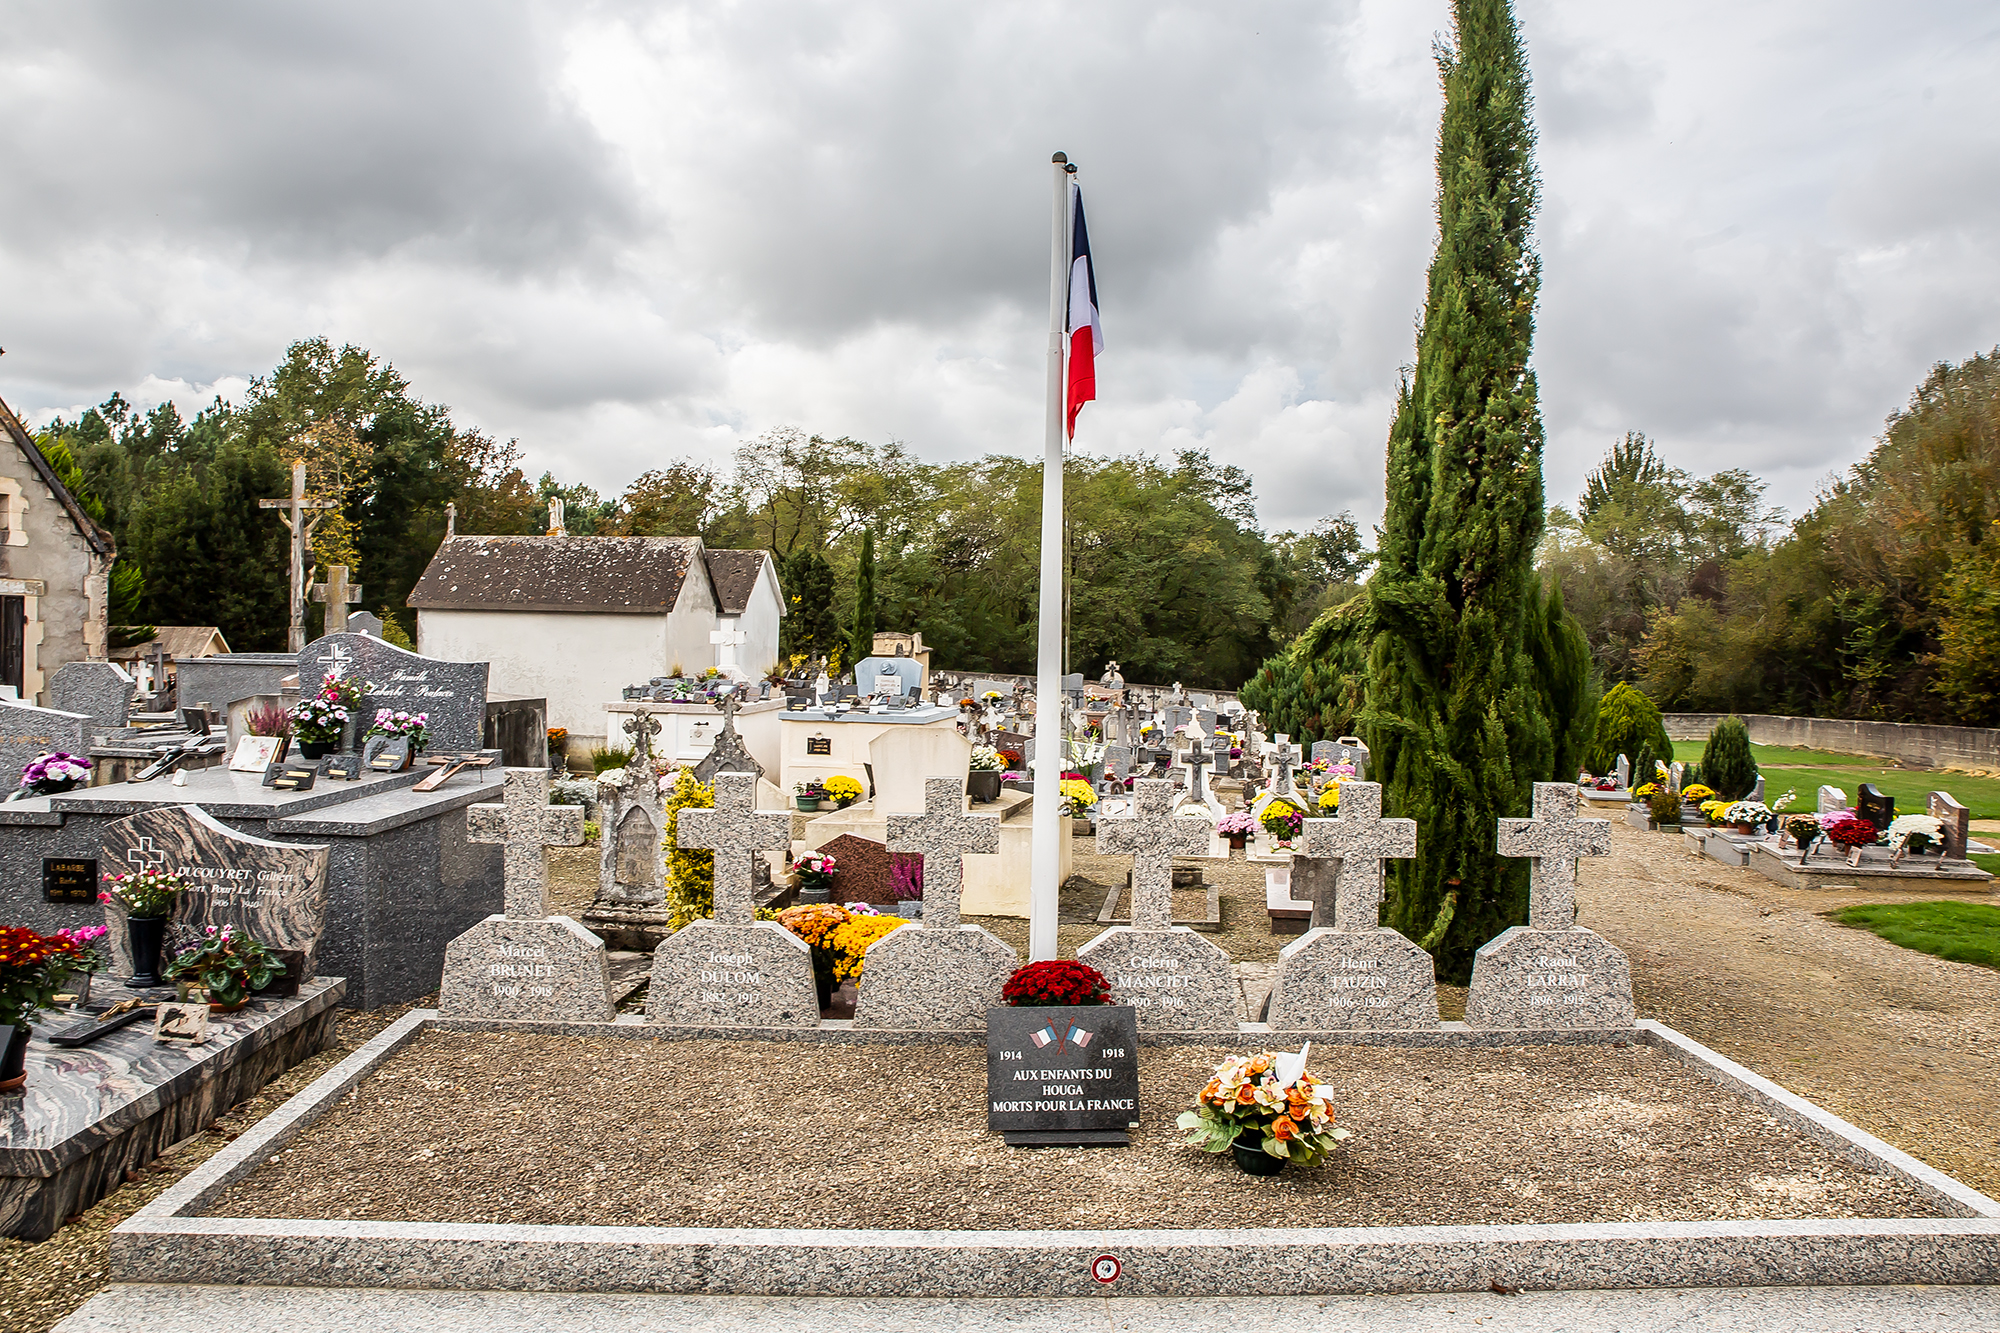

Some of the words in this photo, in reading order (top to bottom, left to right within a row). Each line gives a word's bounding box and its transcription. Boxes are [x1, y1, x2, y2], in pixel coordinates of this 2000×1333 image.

[390, 669, 429, 682] Famille
[176, 866, 253, 880] DUCOUYRET
[257, 870, 294, 883] Gilbert
[211, 884, 234, 894] Pour
[237, 885, 251, 895] La
[256, 886, 289, 897] France
[497, 945, 545, 958] Marcel
[708, 951, 753, 967] Joseph
[1341, 957, 1378, 969] Henri
[1540, 955, 1579, 968] Raoul
[490, 963, 556, 977] BRUNET
[701, 970, 760, 984] DULOM
[1117, 974, 1192, 988] MANCIET
[1331, 975, 1388, 988] TAUZIN
[1527, 973, 1588, 987] LARRAT
[494, 985, 519, 997] 1900
[530, 986, 552, 998] 1918
[738, 992, 760, 1004] 1917
[1127, 996, 1151, 1007] 1890
[1162, 996, 1184, 1007] 1916
[1329, 996, 1353, 1008] 1906
[1364, 996, 1388, 1008] 1926
[999, 1050, 1023, 1061] 1914
[1102, 1048, 1125, 1059] 1918
[1013, 1070, 1039, 1081] AUX
[1040, 1069, 1094, 1081] ENFANTS
[1095, 1068, 1112, 1080] DU
[1042, 1085, 1084, 1096] HOUGA
[993, 1100, 1033, 1112] MORTS
[1035, 1100, 1067, 1112] POUR
[1069, 1100, 1085, 1111] LA
[1087, 1099, 1134, 1111] FRANCE
